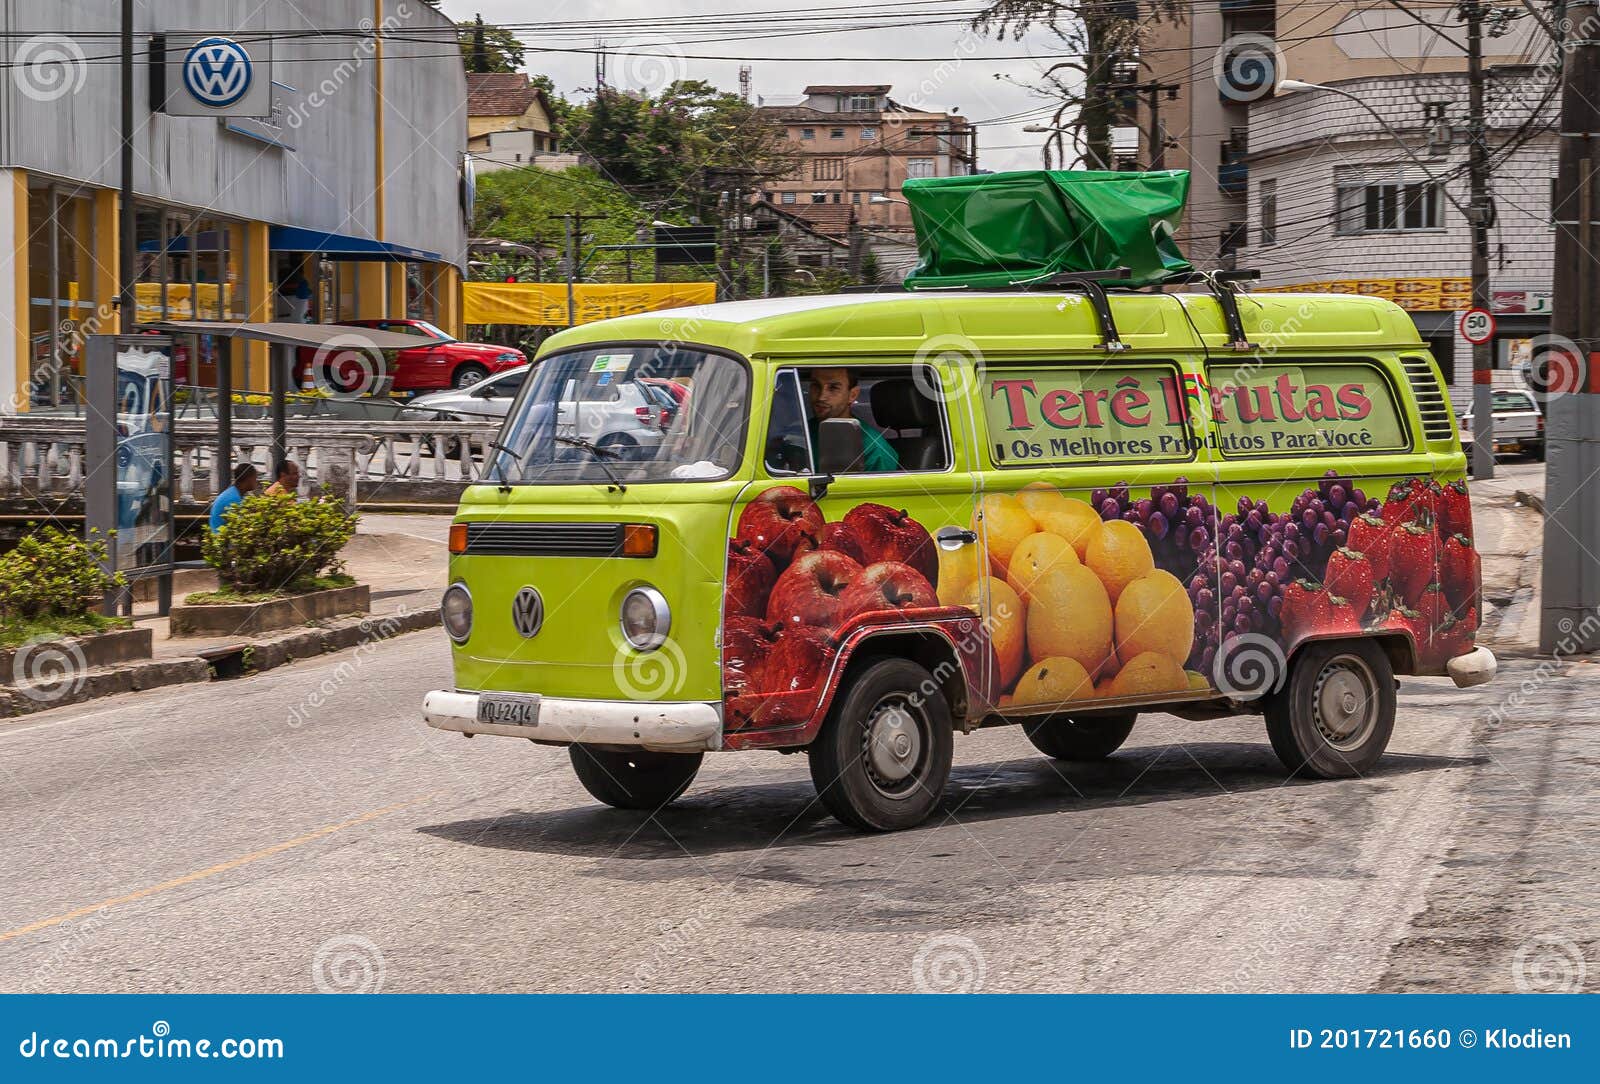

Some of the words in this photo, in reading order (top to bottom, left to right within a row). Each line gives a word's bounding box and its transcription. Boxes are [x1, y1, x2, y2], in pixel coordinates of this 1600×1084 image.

[1467, 315, 1487, 329] 50
[991, 375, 1152, 431] Terê
[1157, 373, 1373, 426] Frutas
[1011, 439, 1044, 459] Os
[1049, 436, 1153, 457] Melhores
[1158, 430, 1266, 453] Produtos
[1270, 430, 1319, 449] Para
[1320, 428, 1373, 447] Você
